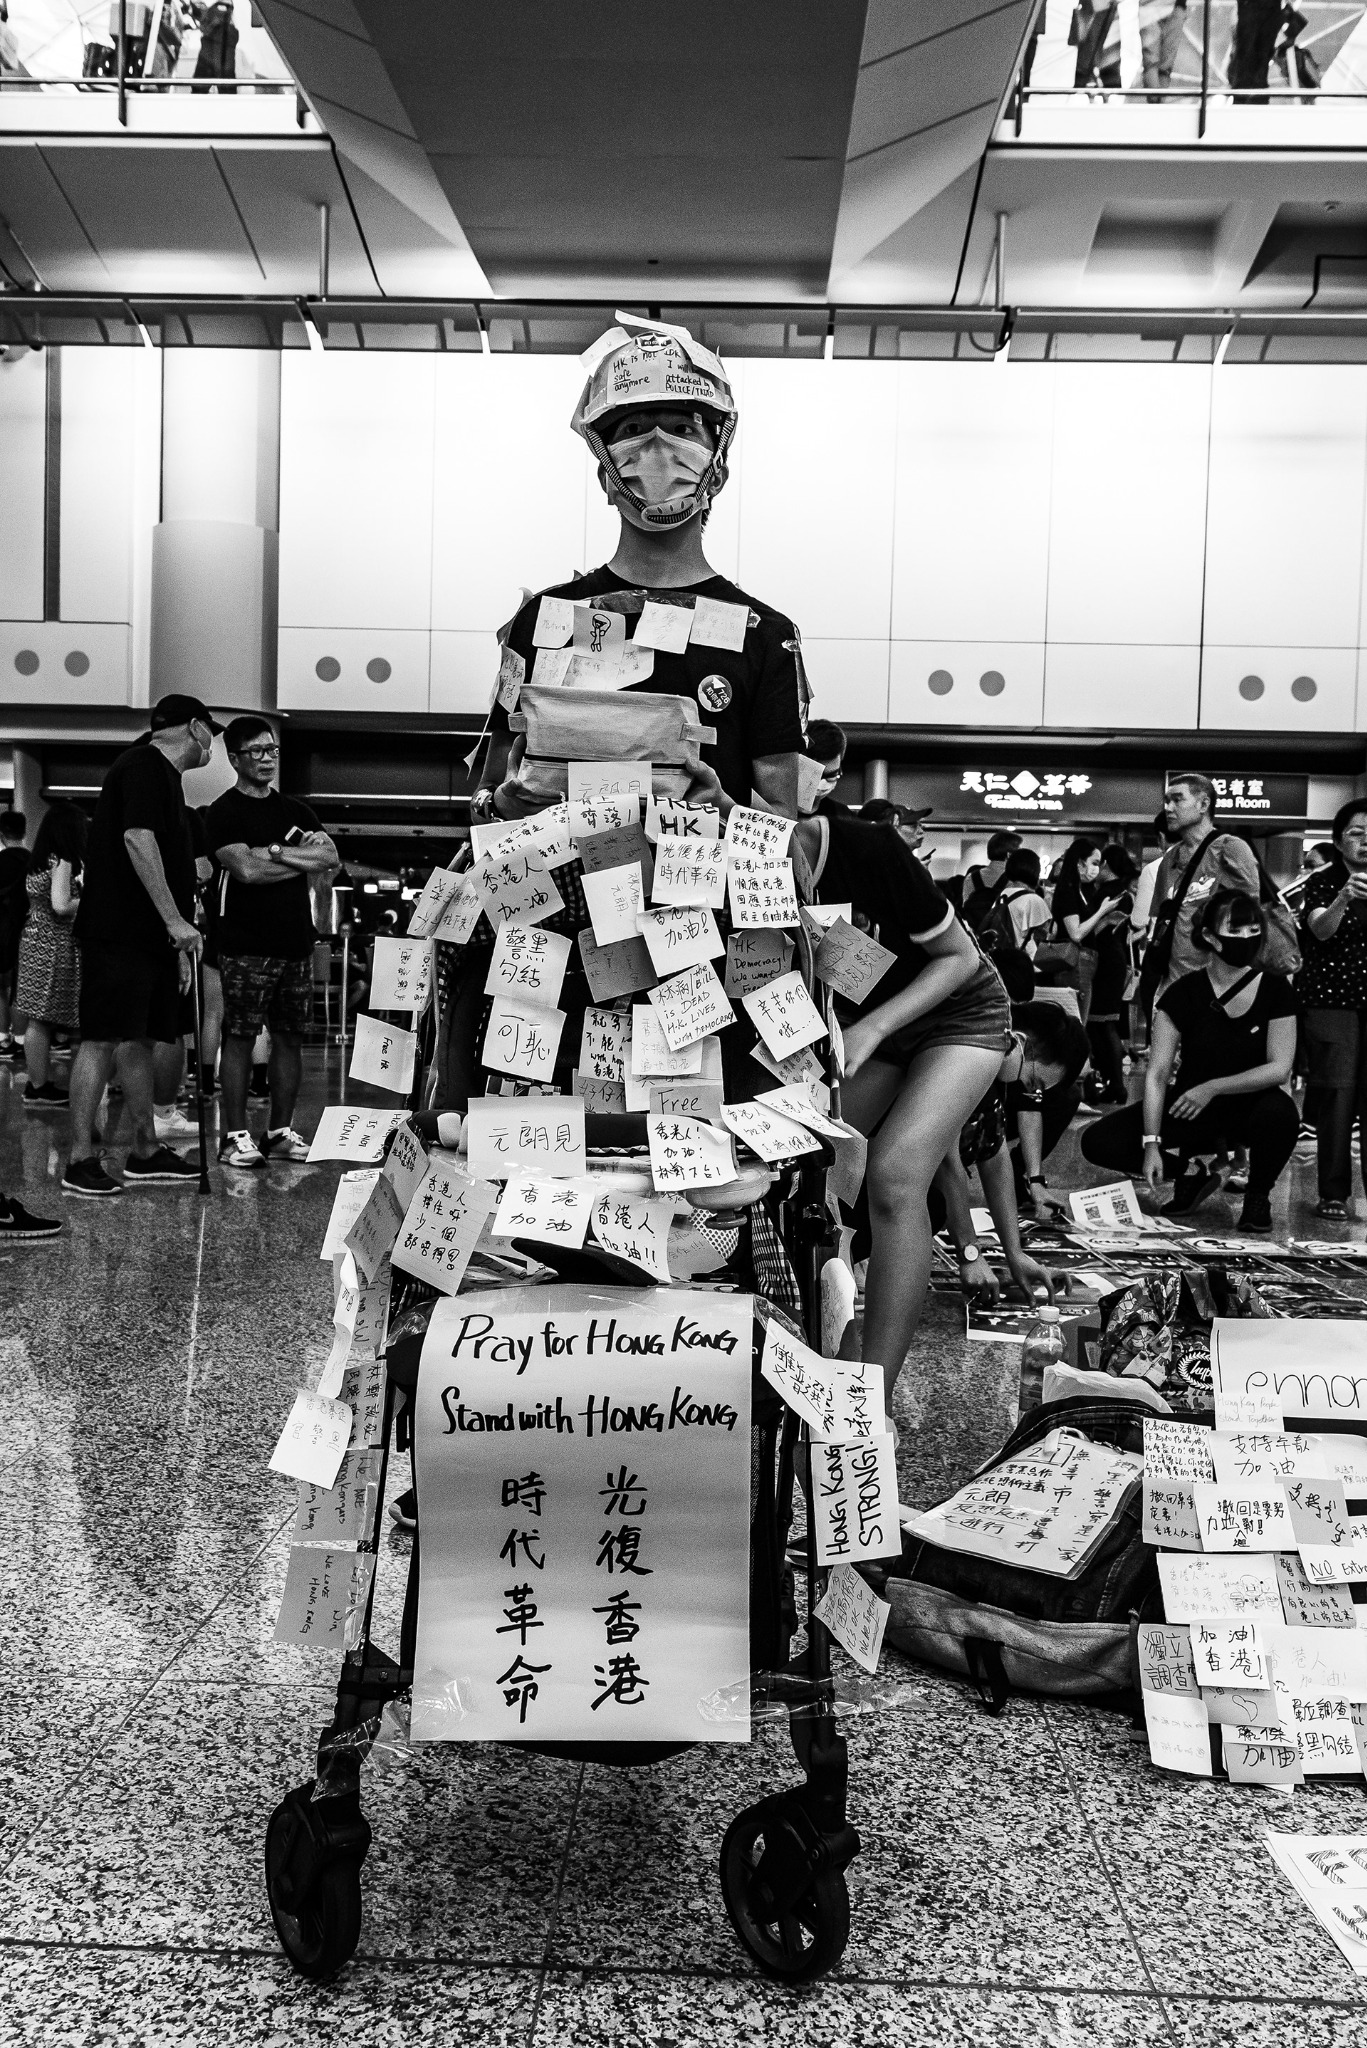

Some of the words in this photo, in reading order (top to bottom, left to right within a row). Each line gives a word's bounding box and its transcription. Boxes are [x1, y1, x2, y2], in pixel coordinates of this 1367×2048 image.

[613, 359, 627, 373] HK
[631, 355, 638, 363] is
[614, 369, 632, 383] safe
[614, 376, 650, 393] anymore
[666, 374, 701, 386] attacked
[959, 771, 1010, 793] 天仁
[1039, 774, 1093, 796] 茗茶
[1235, 796, 1271, 809] Room
[659, 814, 702, 837] HK
[662, 843, 723, 863] 光復香港
[482, 857, 543, 894] 香港人
[660, 864, 719, 888] 時代革命
[497, 887, 549, 922] 加油
[665, 911, 709, 948] 加油!
[505, 926, 548, 962] 警黑
[734, 939, 756, 953] HK
[499, 959, 541, 988] 勾結
[693, 965, 708, 976] the
[752, 970, 776, 980] want
[664, 1009, 675, 1019] is
[681, 991, 710, 1014] DEAD
[667, 1018, 688, 1033] H.K.
[382, 1036, 394, 1055] Free
[658, 1088, 703, 1115] Free
[366, 1120, 378, 1129] IS
[488, 1119, 581, 1153] 元朗見
[358, 1134, 371, 1147] NOT
[428, 1173, 466, 1206] 香港人
[520, 1182, 579, 1206] 香港
[508, 1212, 573, 1232] 加油
[452, 1313, 536, 1375] Pray
[540, 1320, 580, 1356] for
[1189, 1360, 1212, 1382] hyp
[441, 1385, 515, 1435] Stand
[518, 1396, 576, 1434] with
[819, 1443, 847, 1498] KONG
[1233, 1458, 1296, 1477] 加油
[353, 1488, 367, 1509] ARE
[964, 1488, 1011, 1505] 元朗
[824, 1498, 851, 1558] HONG
[1309, 1559, 1333, 1577] NO
[495, 1470, 554, 1724] 時代革命
[589, 1464, 655, 1712] 光復香港
[1198, 1624, 1256, 1652] 加油!
[1205, 1646, 1264, 1680] 香港!
